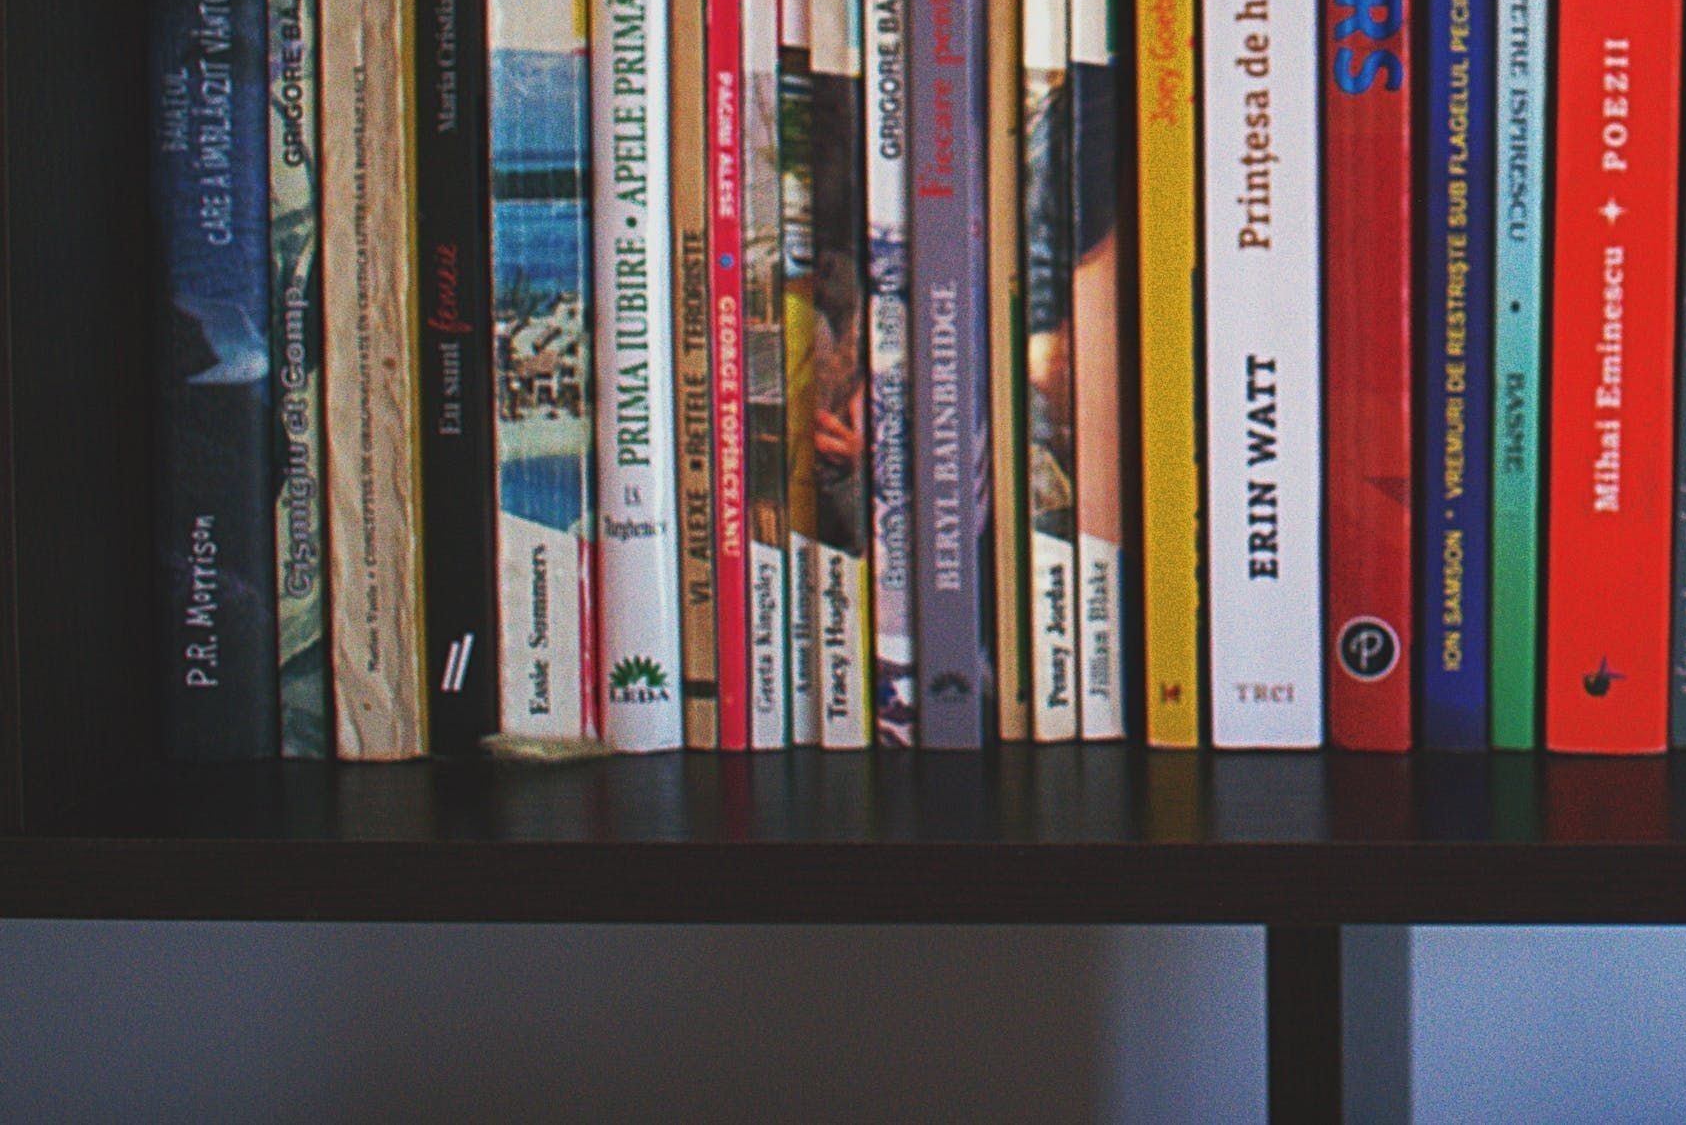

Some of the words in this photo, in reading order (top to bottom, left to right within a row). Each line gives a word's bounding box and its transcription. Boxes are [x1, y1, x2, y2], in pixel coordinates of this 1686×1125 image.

[281, 46, 304, 168] GRIGORE
[877, 39, 902, 161] GRIGORE
[1235, 33, 1269, 79] de
[1600, 37, 1630, 172] POEZII
[613, 105, 647, 209] APELE
[1448, 58, 1470, 175] FLAGELUL
[1508, 87, 1531, 244] ISPIRESCU
[1446, 179, 1469, 228] SUB
[614, 236, 649, 351] IUBIRE
[718, 294, 738, 394] GEORGE
[1595, 245, 1626, 408] Eminescu
[440, 341, 462, 397] sunt
[616, 361, 651, 468] PRIMA
[929, 280, 960, 482] BAINBRIDGE
[1245, 354, 1278, 468] WATT
[1445, 363, 1466, 393] DE
[1444, 397, 1466, 499] VREMURI
[1505, 372, 1527, 474] BASME
[1594, 419, 1621, 512] Mihai
[184, 515, 217, 628] Morrison
[933, 488, 961, 591] BERYL
[1247, 480, 1280, 581] ERIN
[1443, 529, 1463, 626] SAMSON
[527, 544, 550, 651] Summers
[822, 555, 848, 649] Hughes
[185, 634, 220, 688] P.R.
[825, 655, 850, 723] Tracy
[1045, 645, 1071, 710] Penny
[1442, 630, 1462, 672] ION
